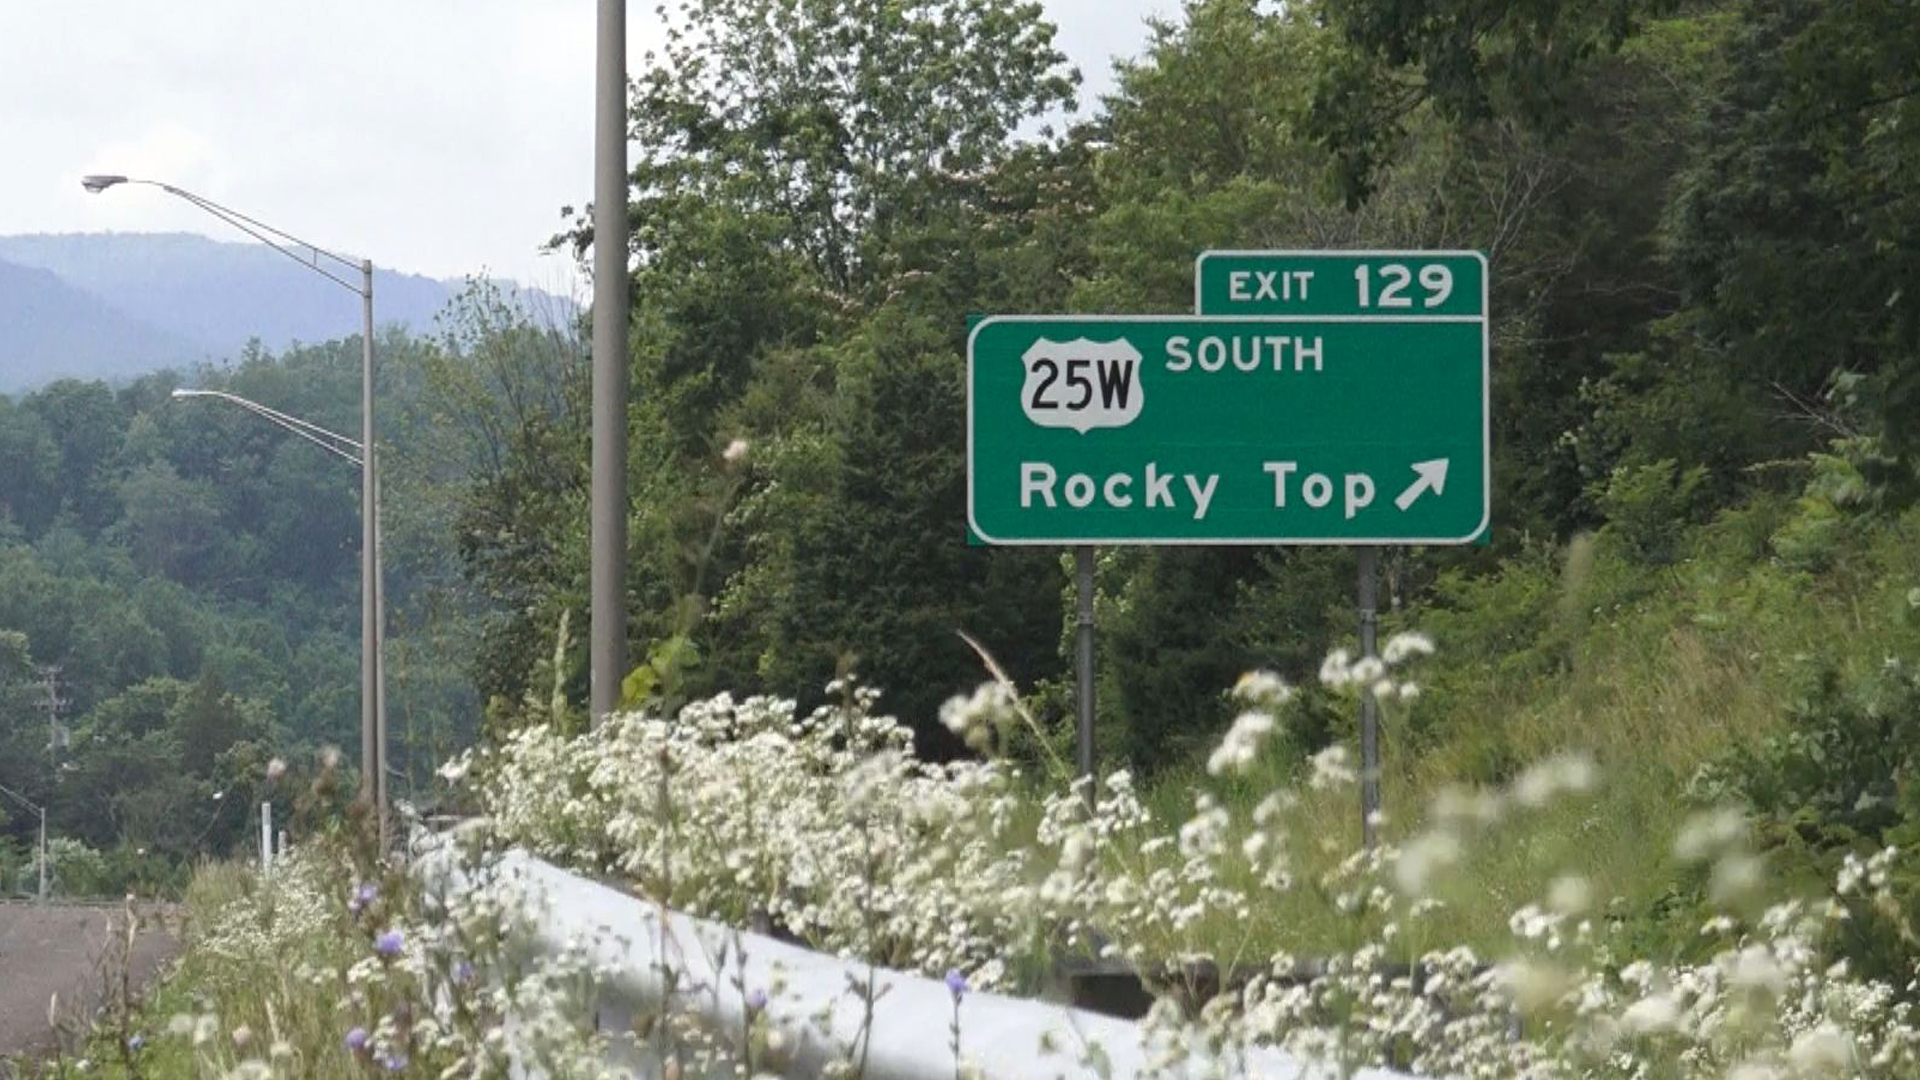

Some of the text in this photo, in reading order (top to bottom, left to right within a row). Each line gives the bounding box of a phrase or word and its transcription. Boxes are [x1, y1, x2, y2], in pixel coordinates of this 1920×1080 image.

[1229, 264, 1453, 307] EXIT 129
[1165, 336, 1324, 372] SOUTH
[1031, 357, 1133, 411] 25W
[1020, 462, 1376, 519] Rocky Top
